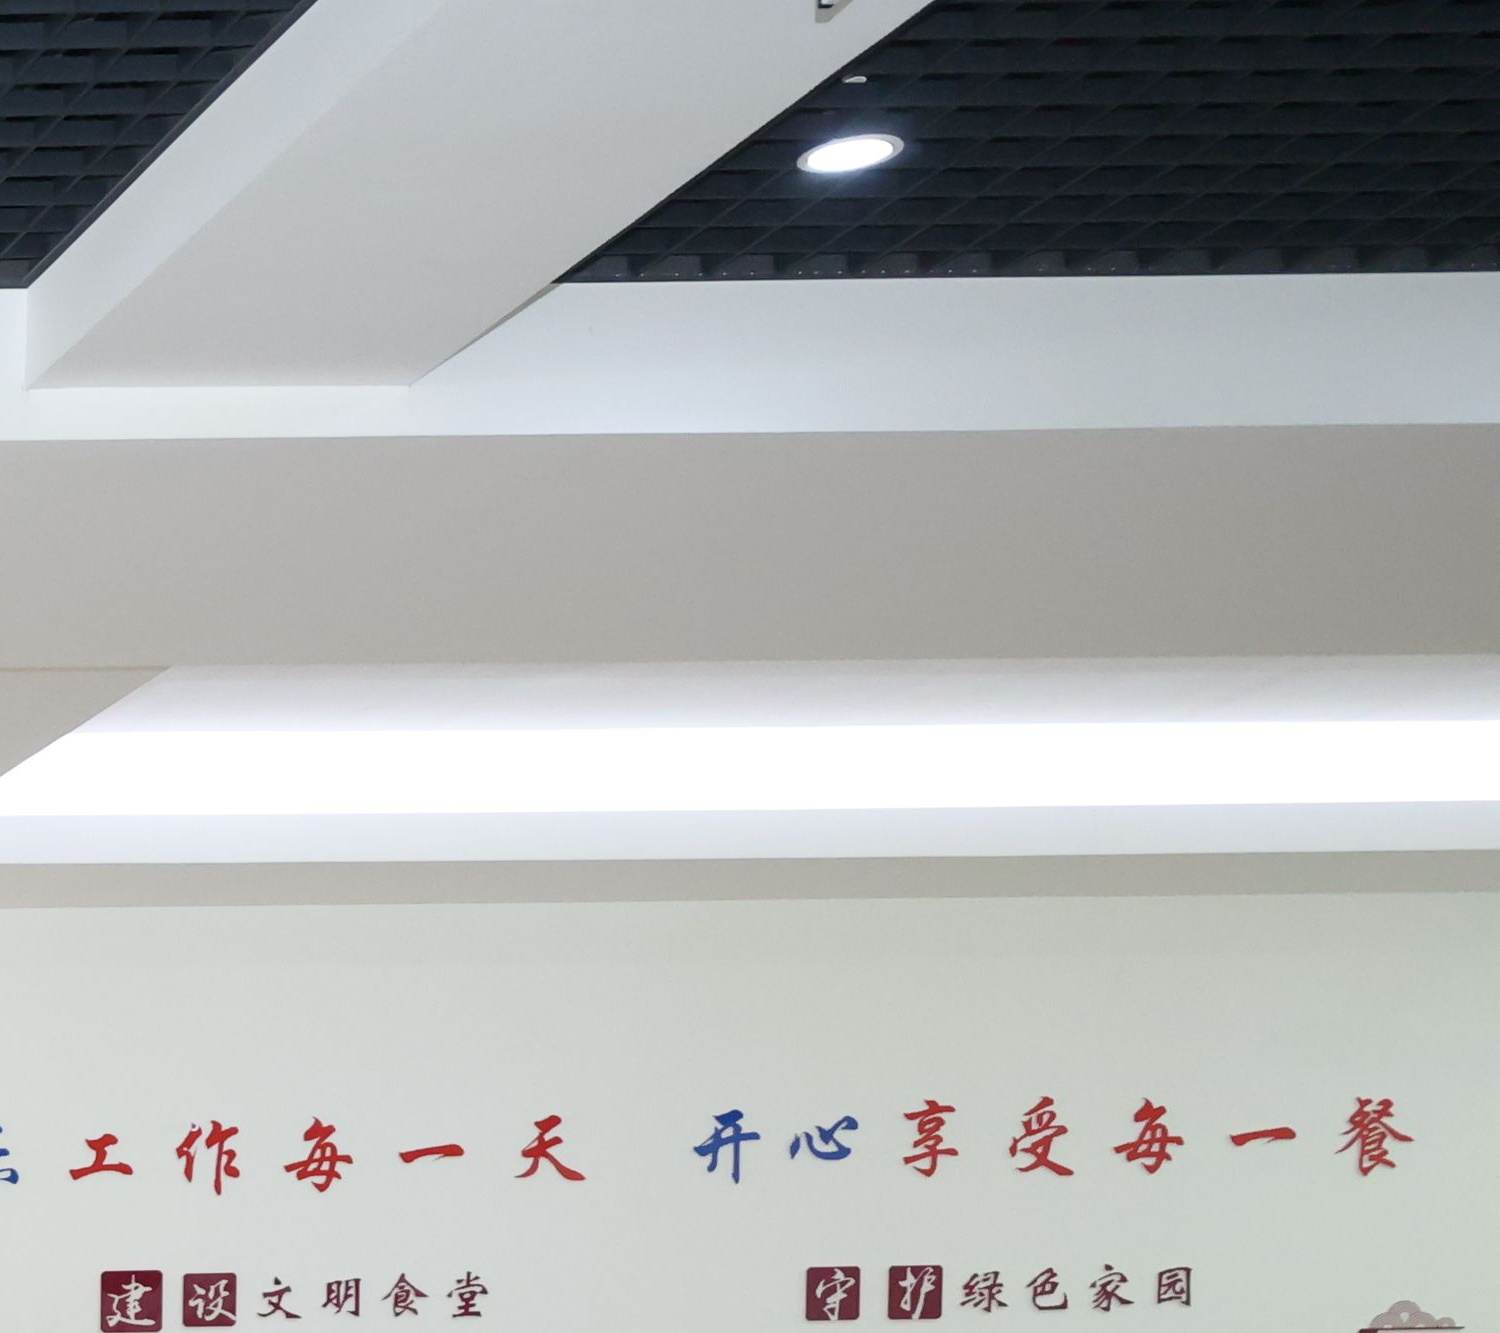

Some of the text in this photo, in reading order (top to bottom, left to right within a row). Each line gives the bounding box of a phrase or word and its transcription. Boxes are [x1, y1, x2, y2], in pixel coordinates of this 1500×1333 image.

[693, 1095, 1414, 1184] 开心享受每一餐
[101, 1270, 489, 1333] 建设文明食堂
[806, 1265, 1193, 1321] 守护绿色家园
